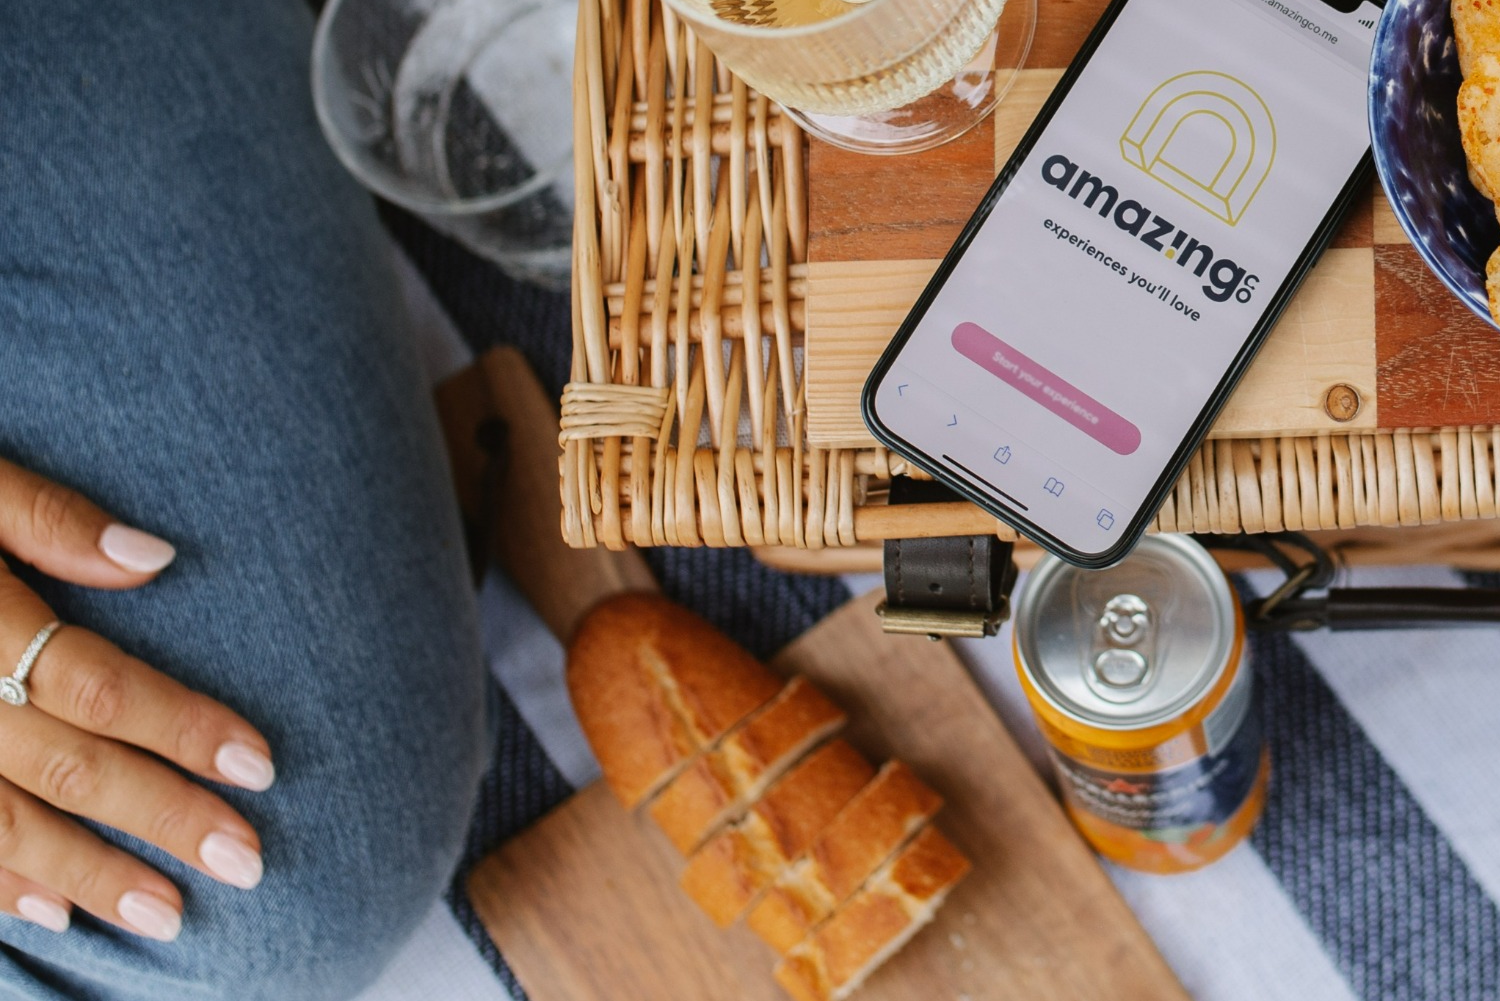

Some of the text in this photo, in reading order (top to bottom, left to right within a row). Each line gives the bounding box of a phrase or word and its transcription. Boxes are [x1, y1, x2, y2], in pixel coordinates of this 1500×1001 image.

[1043, 218, 1201, 322] experiences you'll love
[992, 351, 1099, 425] Start your experience
